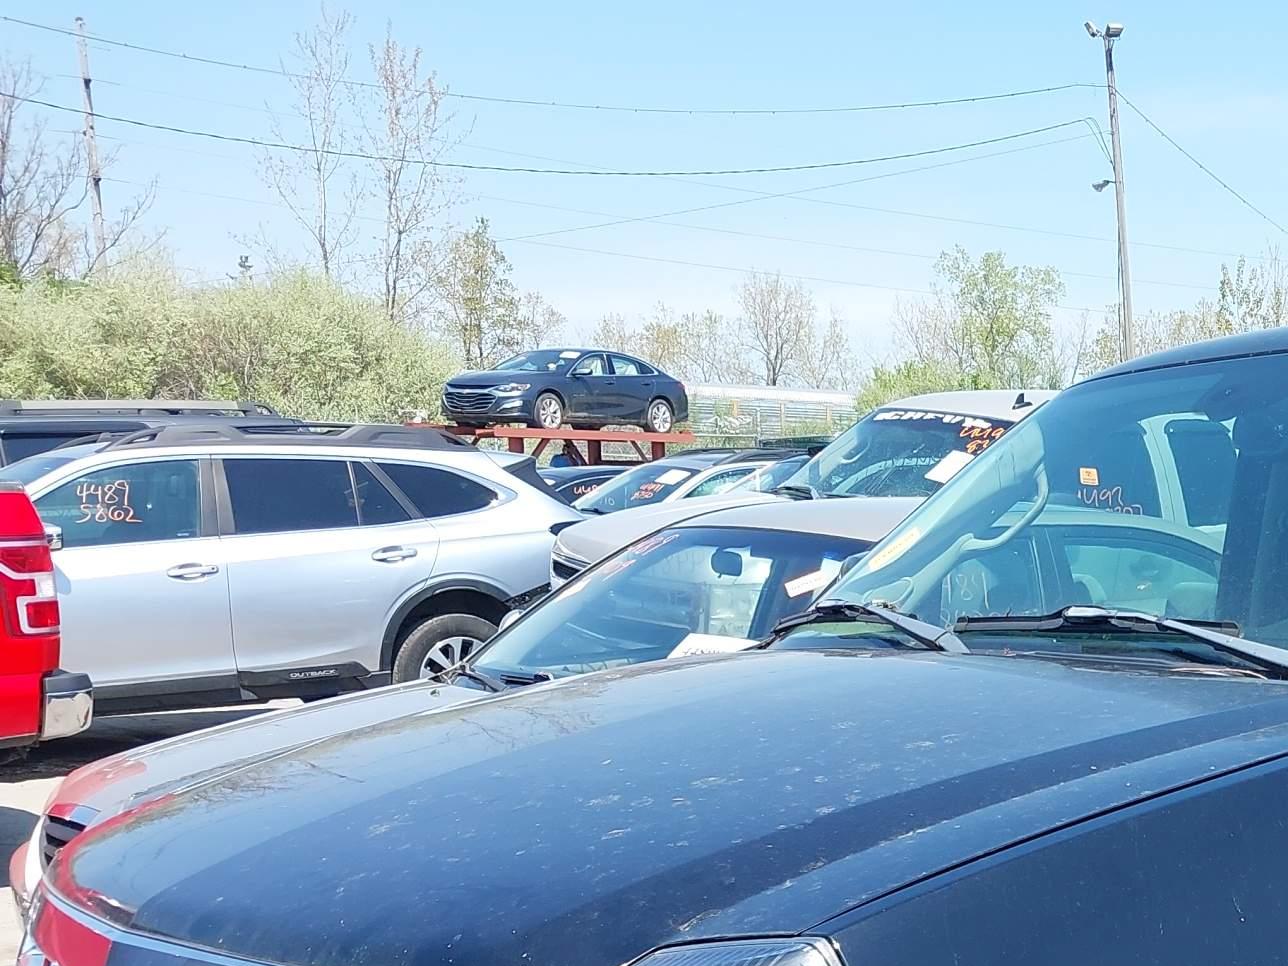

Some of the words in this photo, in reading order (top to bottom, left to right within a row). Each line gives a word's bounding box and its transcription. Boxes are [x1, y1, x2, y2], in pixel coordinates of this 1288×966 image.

[76, 480, 129, 506] 4489
[75, 503, 144, 523] 5862
[289, 669, 338, 680] OUTBACK
